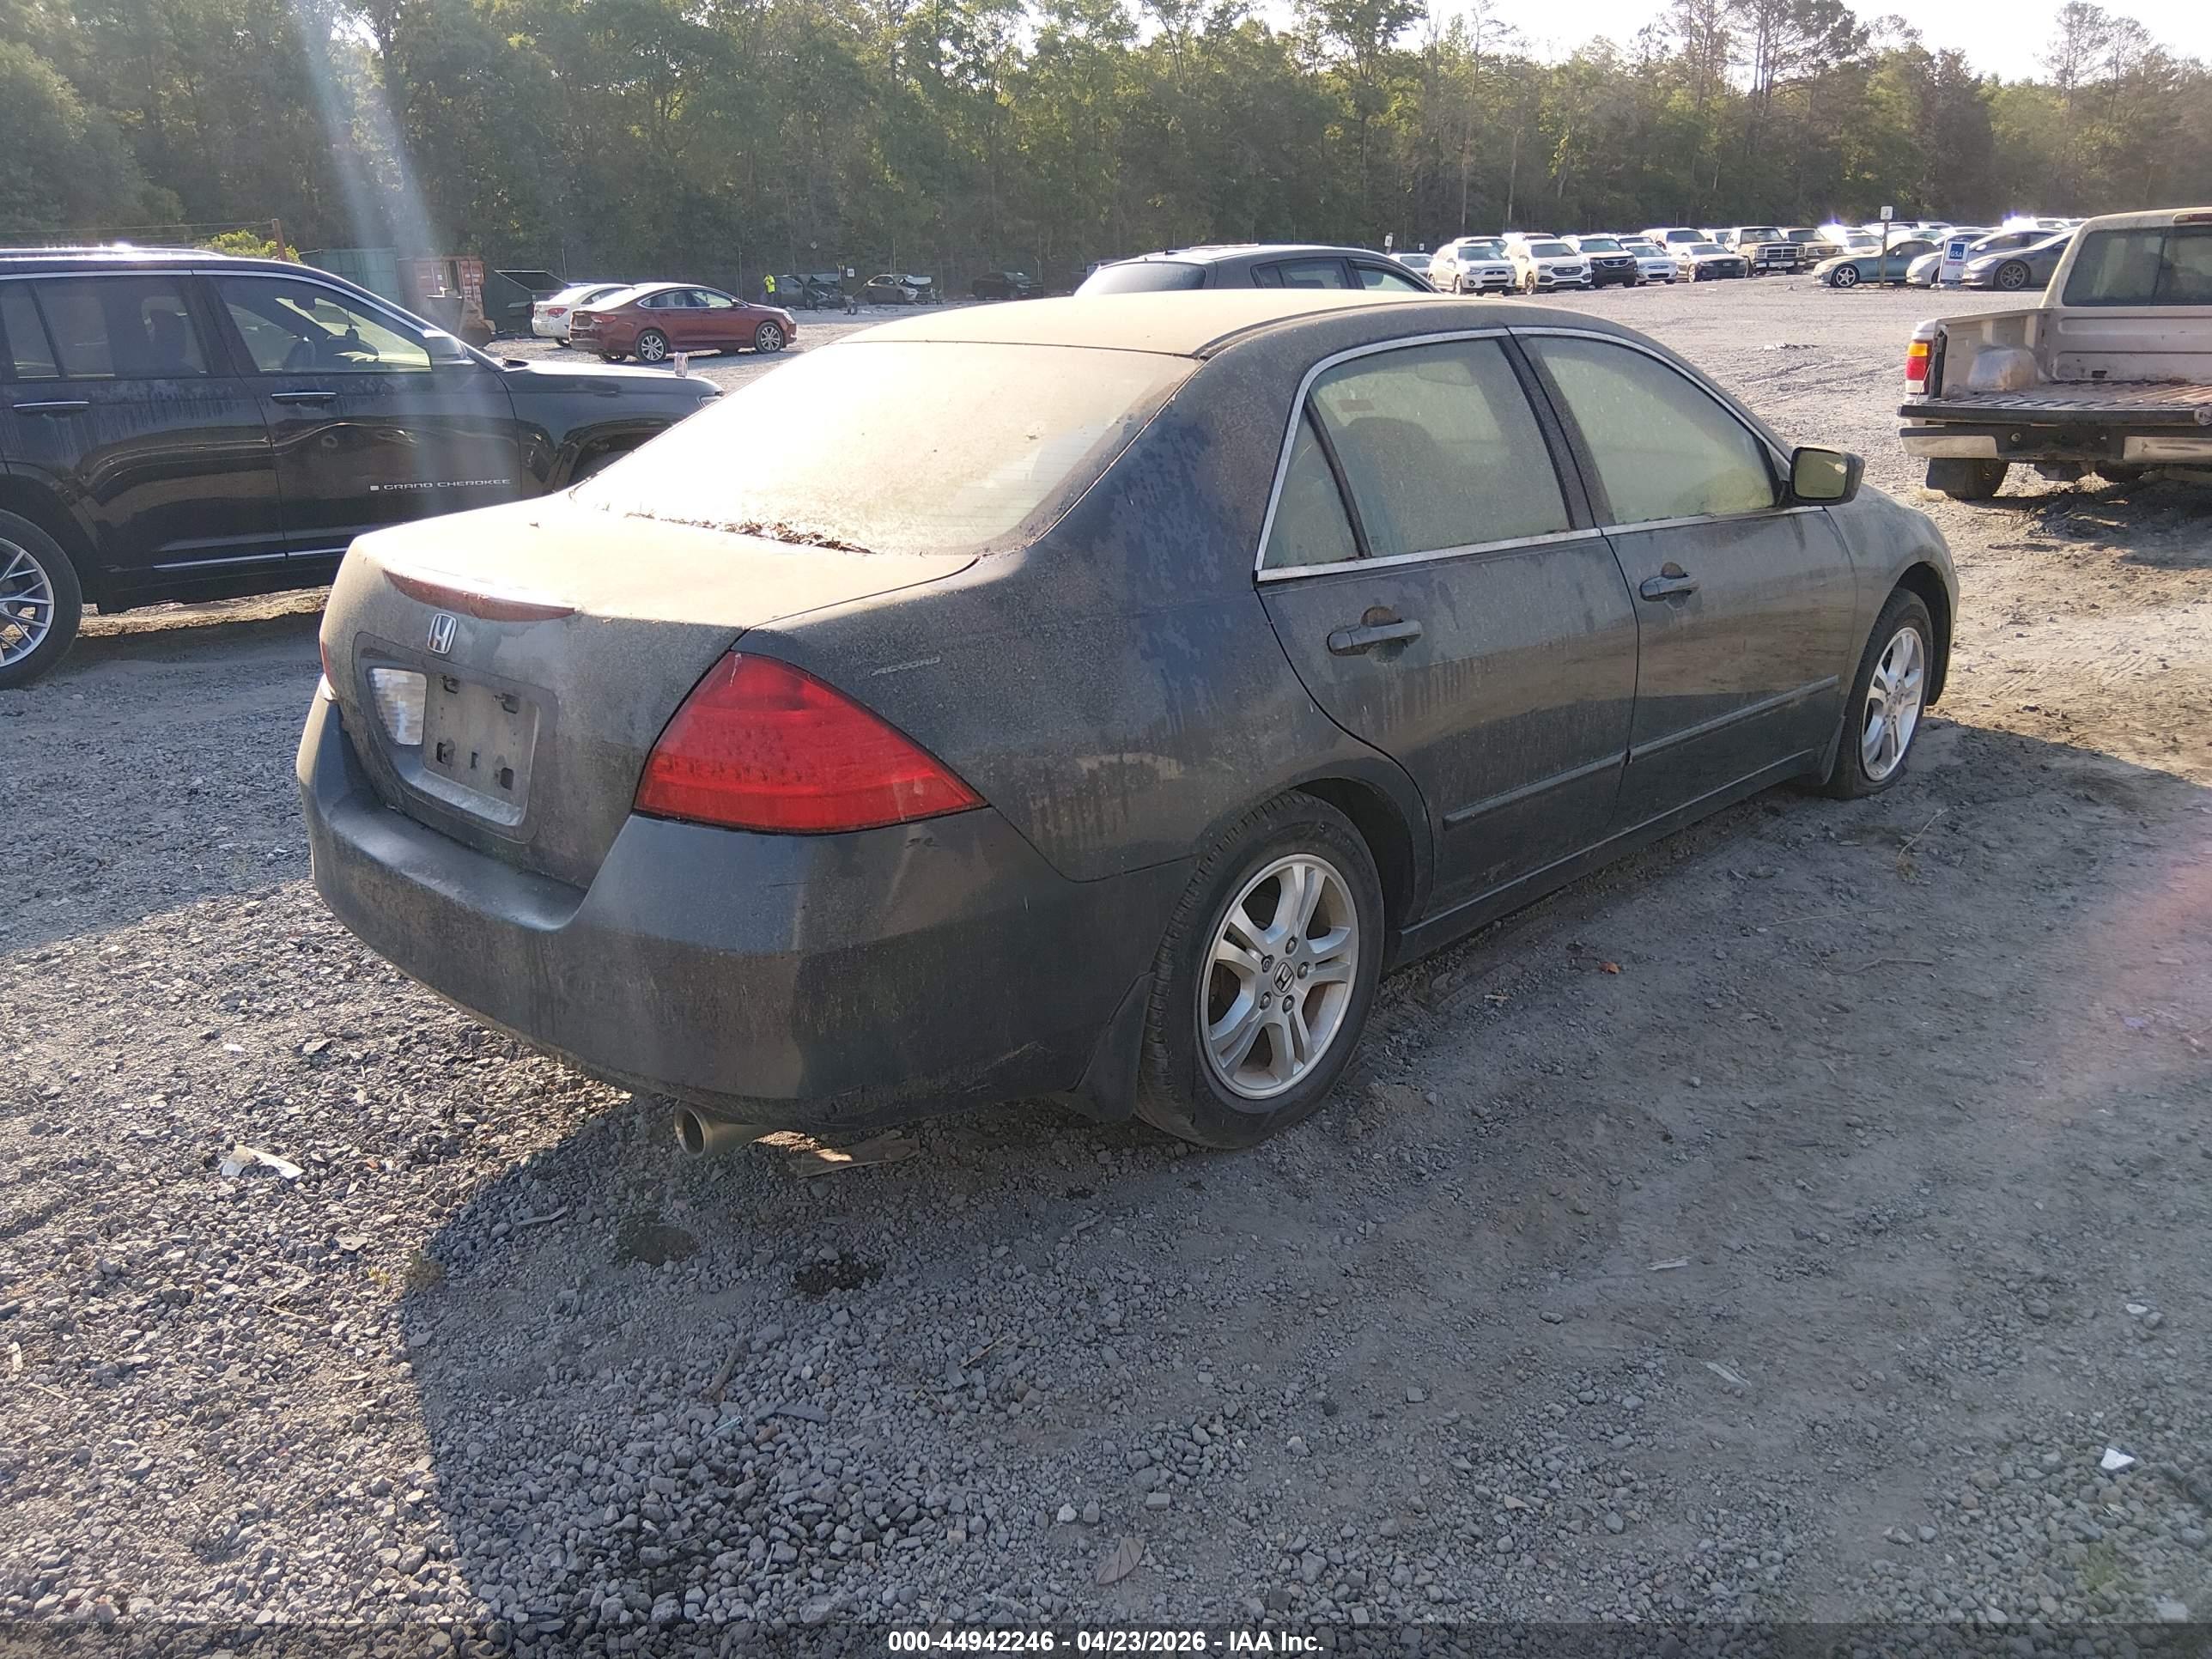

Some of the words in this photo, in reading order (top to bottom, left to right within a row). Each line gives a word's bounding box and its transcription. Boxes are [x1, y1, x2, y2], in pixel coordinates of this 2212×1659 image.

[383, 482, 433, 490] GRAND
[437, 479, 510, 488] CHEROKEE
[871, 656, 941, 676] ACCORD
